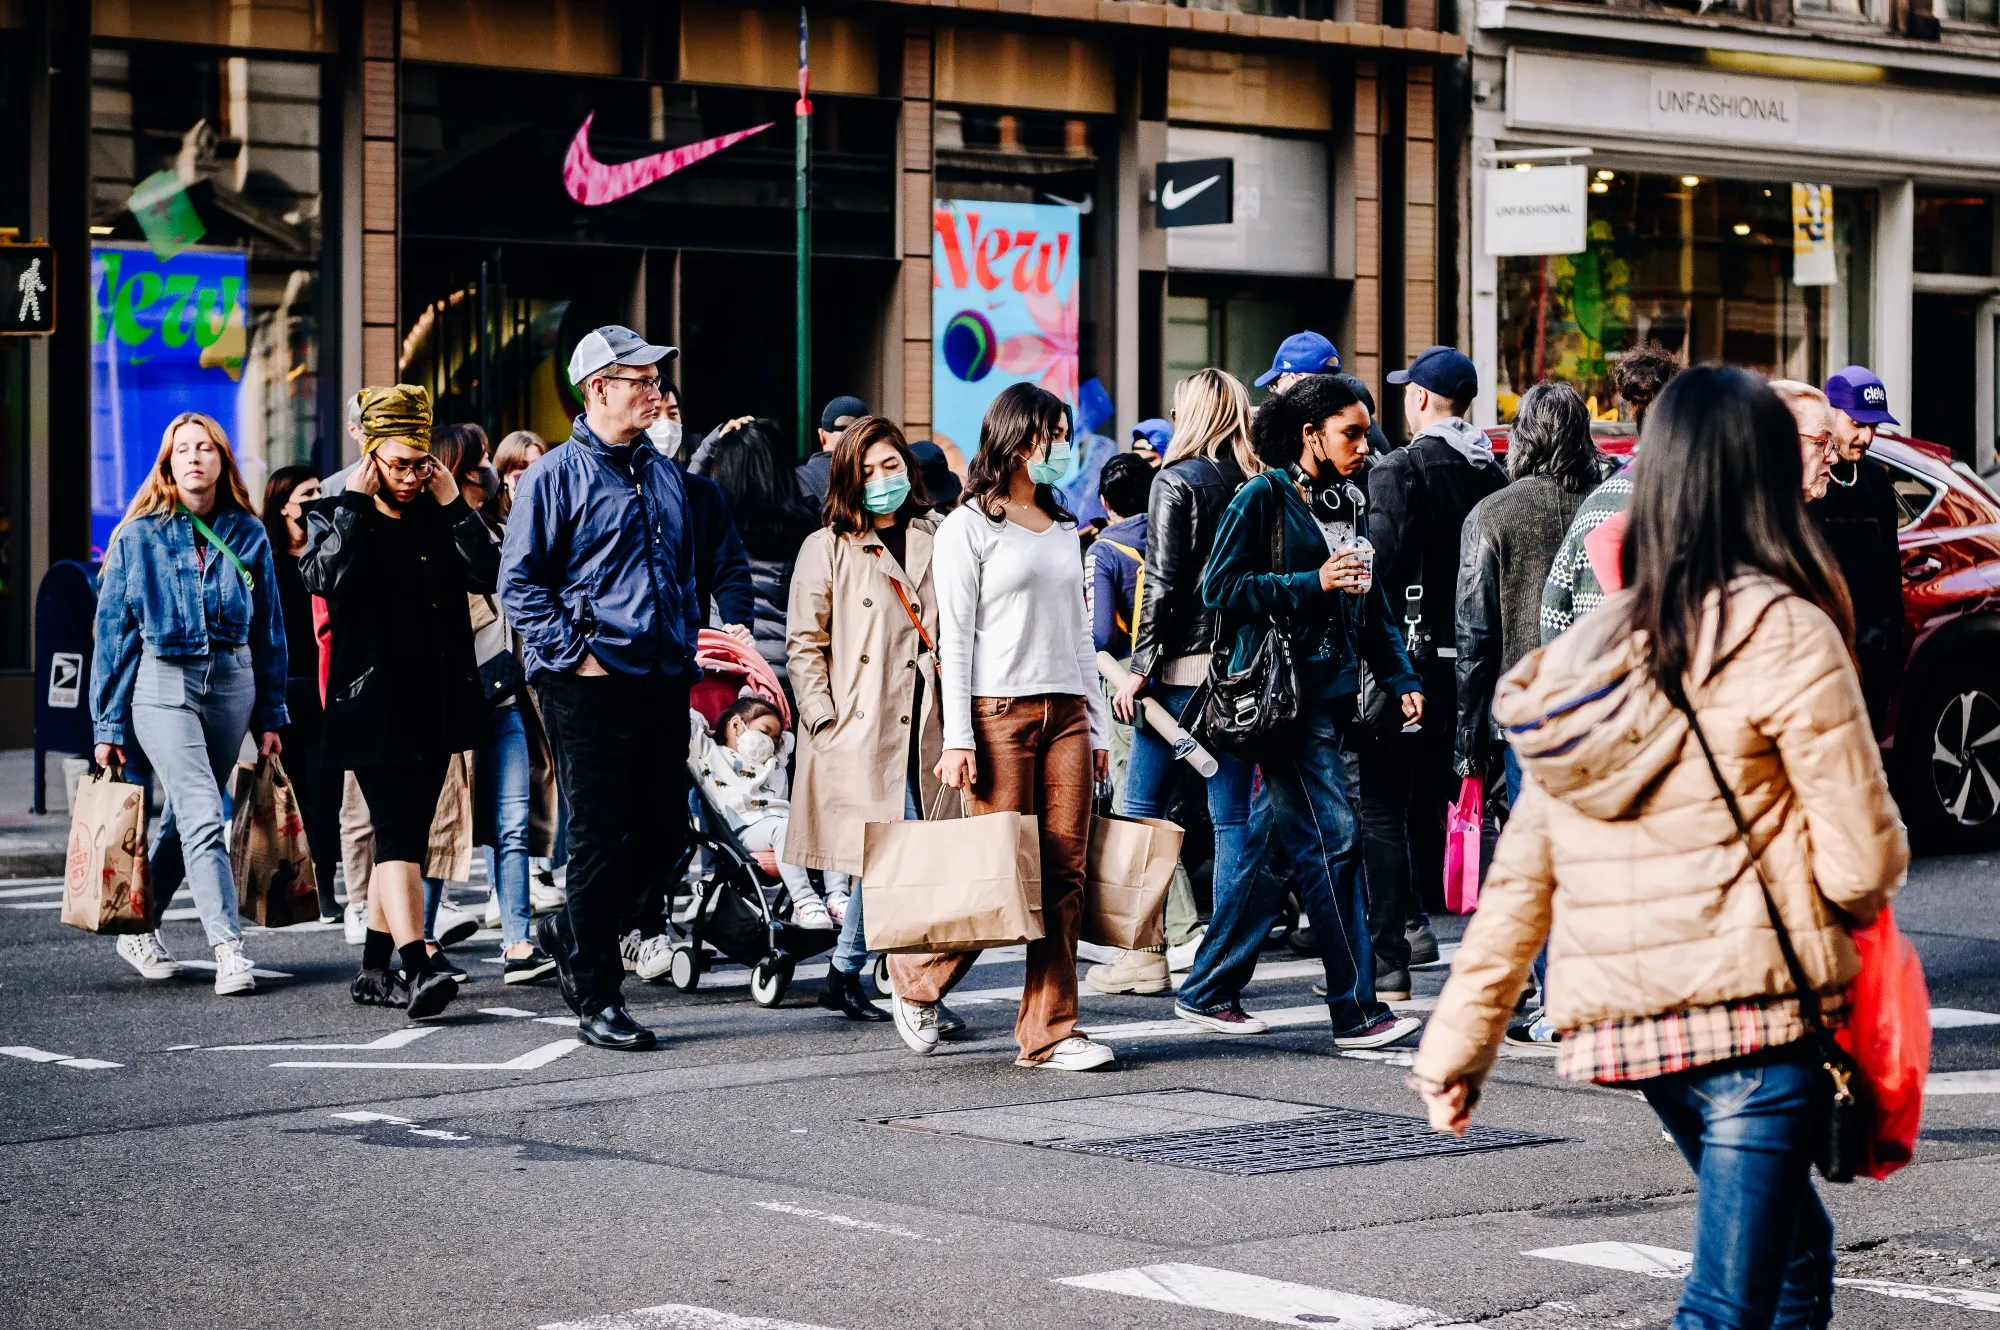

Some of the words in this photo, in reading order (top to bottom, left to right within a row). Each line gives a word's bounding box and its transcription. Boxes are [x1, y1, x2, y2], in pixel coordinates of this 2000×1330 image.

[1657, 88, 1790, 124] UNFASHIONAL
[1495, 203, 1573, 218] UNFASHIONAL
[933, 208, 1072, 294] New
